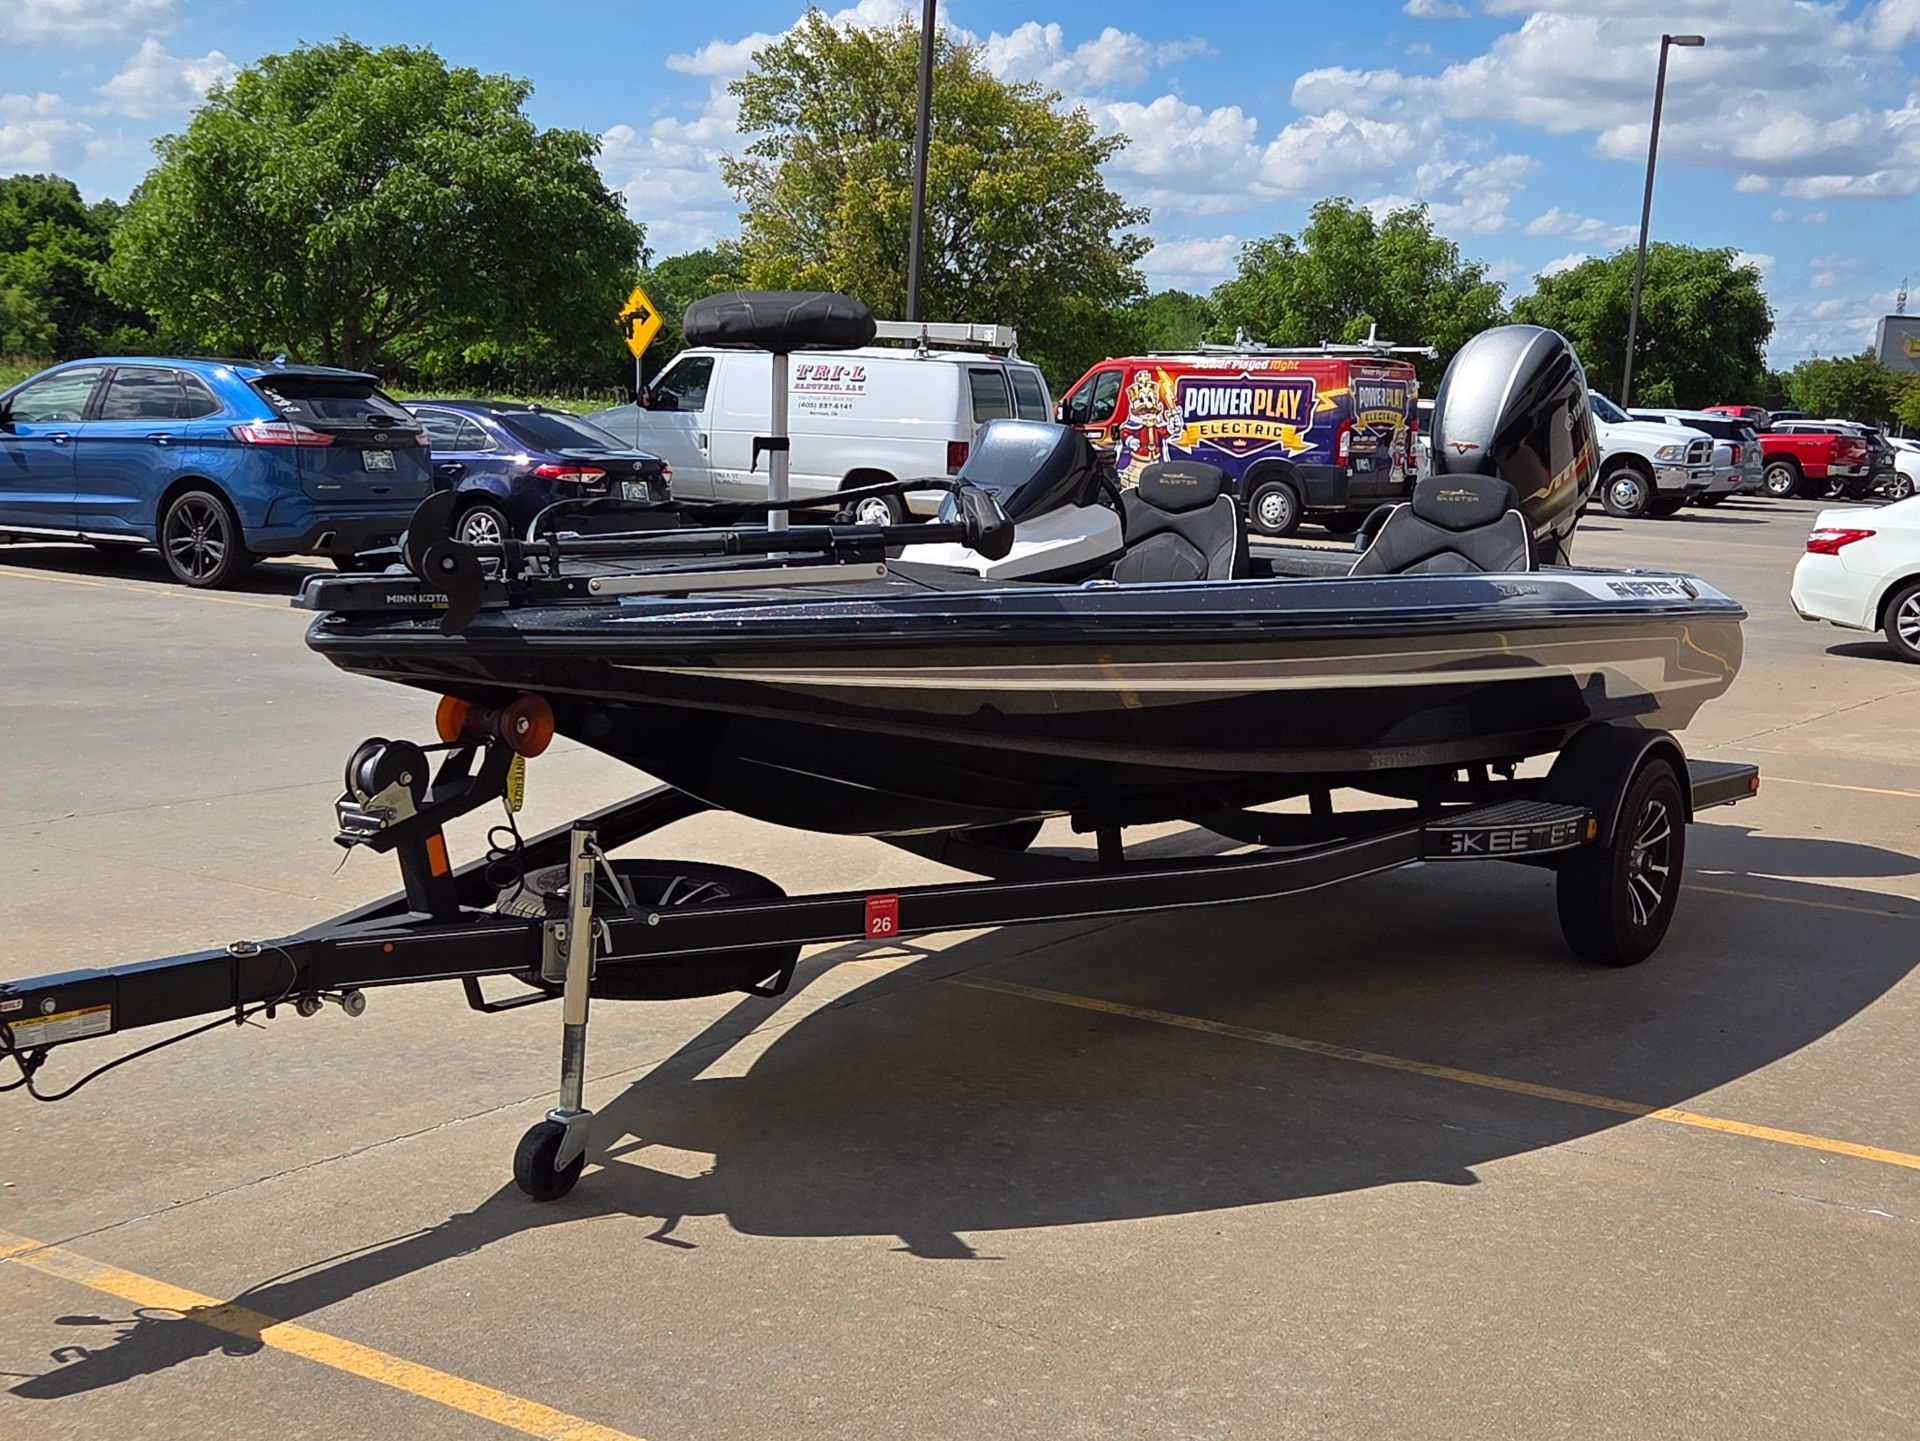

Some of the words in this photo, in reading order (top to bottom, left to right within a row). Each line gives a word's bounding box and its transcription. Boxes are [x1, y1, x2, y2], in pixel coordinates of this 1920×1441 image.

[1269, 360, 1300, 371] Right
[1183, 387, 1303, 420] POWERPLAY
[1365, 411, 1398, 423] ELECTRIC
[1199, 422, 1283, 438] ELECTRIC
[386, 594, 417, 604] MINN
[418, 594, 449, 603] KOTA
[872, 916, 892, 934] 26
